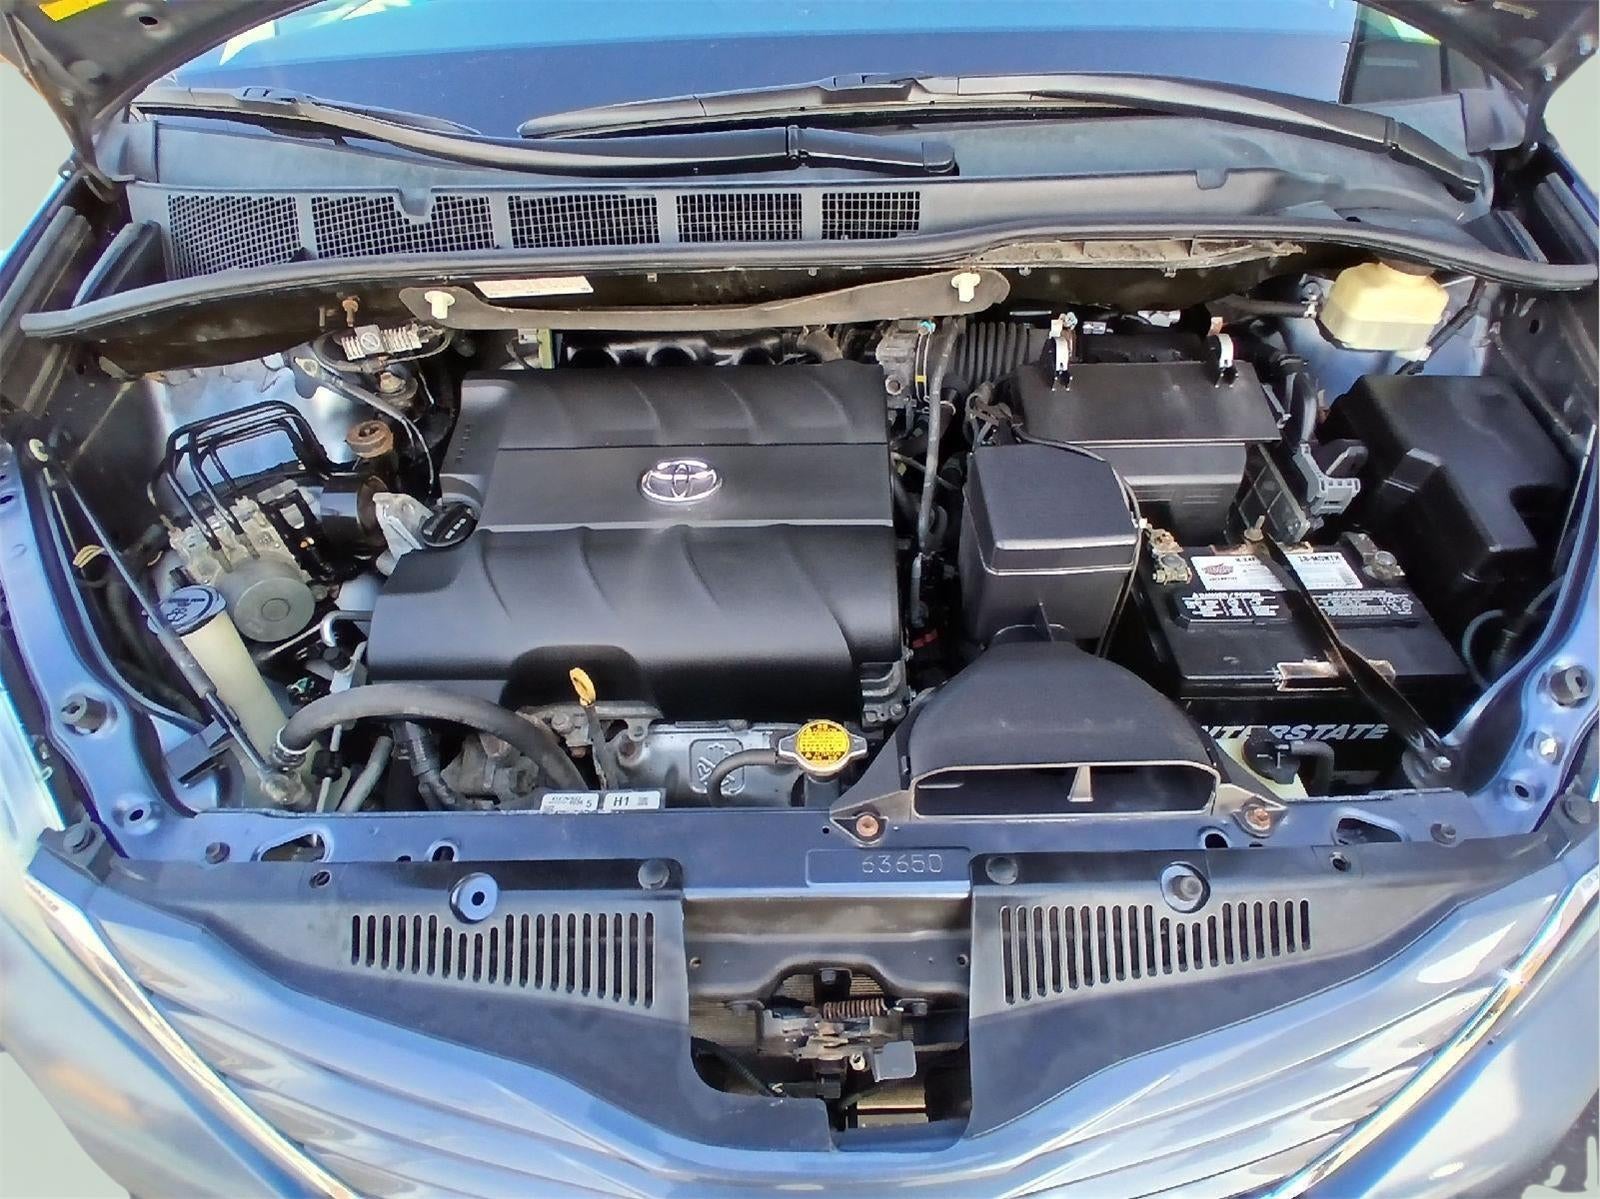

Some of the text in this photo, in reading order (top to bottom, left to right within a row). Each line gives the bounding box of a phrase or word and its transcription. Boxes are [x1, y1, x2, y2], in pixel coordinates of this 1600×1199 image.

[1201, 724, 1389, 741] NTERSTATE
[613, 796, 630, 807] H1
[861, 853, 944, 874] 63650
